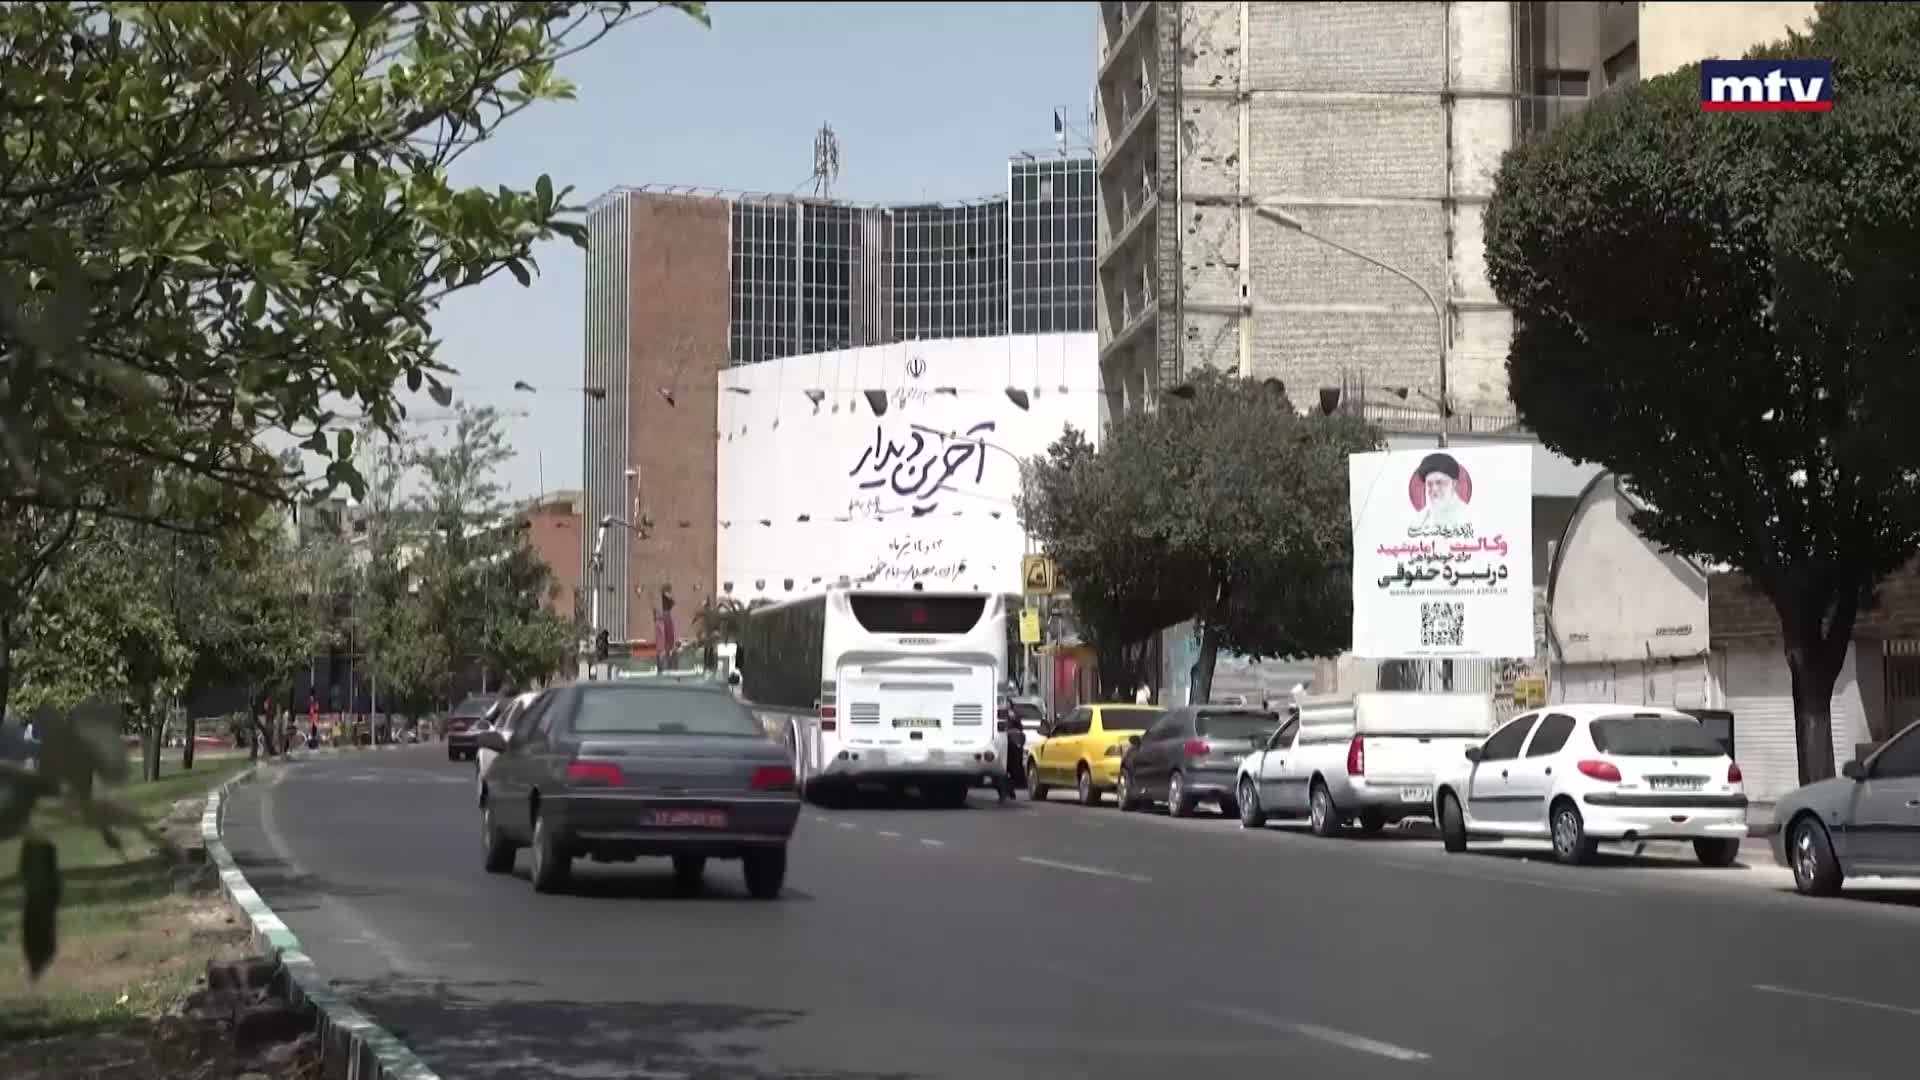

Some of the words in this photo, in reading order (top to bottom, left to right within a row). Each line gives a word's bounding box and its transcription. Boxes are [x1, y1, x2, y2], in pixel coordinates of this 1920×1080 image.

[849, 425, 925, 489] دیدار
[891, 421, 996, 517] آخرین
[1450, 534, 1508, 556] وکالت
[1377, 562, 1441, 588] حقوقی
[1443, 562, 1491, 586] نبرد
[1487, 562, 1508, 586] در
